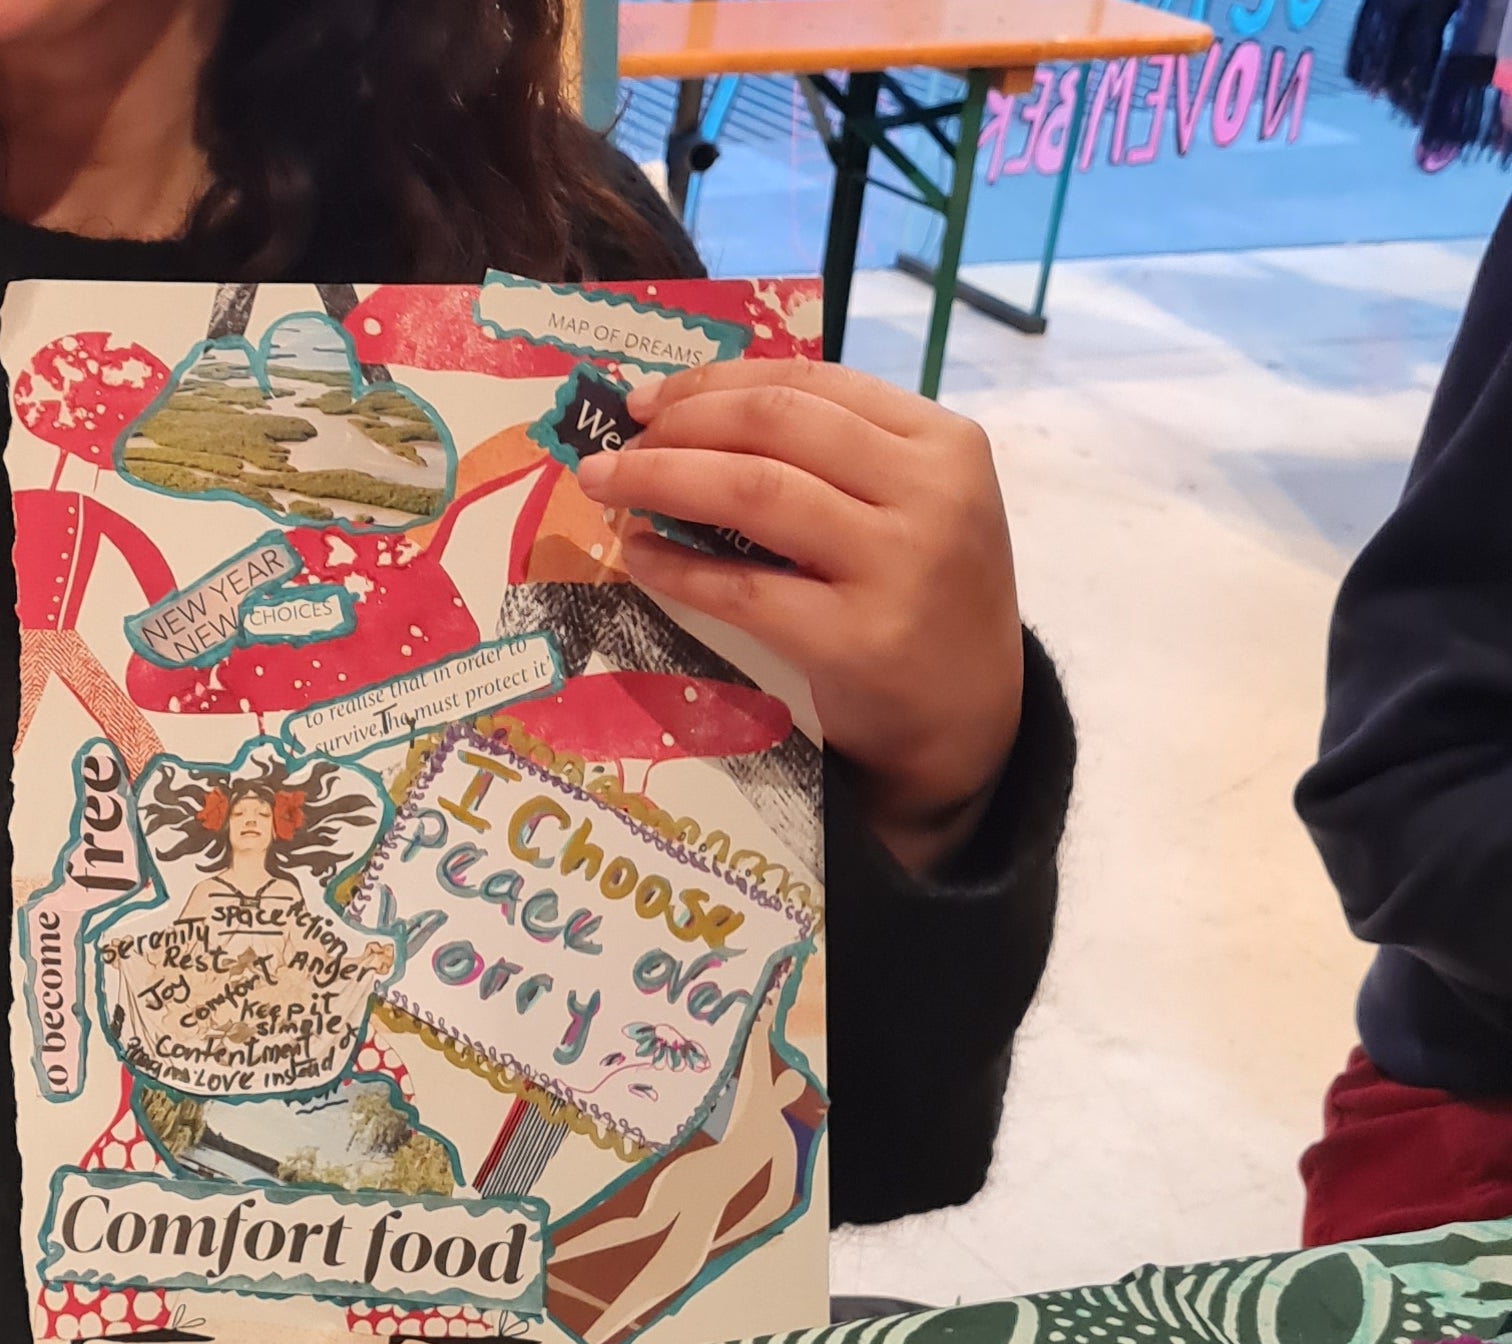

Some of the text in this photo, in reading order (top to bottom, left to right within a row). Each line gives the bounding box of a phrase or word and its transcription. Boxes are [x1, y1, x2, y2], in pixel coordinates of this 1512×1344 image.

[548, 312, 703, 367] MAP OF DREAMS
[576, 398, 624, 452] We
[141, 549, 285, 648] NEW YEAR
[174, 608, 240, 662] NEW
[248, 601, 334, 627] CHOICES
[303, 638, 528, 729] to realise that in order to
[414, 694, 460, 721] must
[464, 668, 530, 711] protect
[65, 755, 137, 893] free
[38, 910, 67, 1054] become
[61, 1193, 533, 1285] Comfort food
